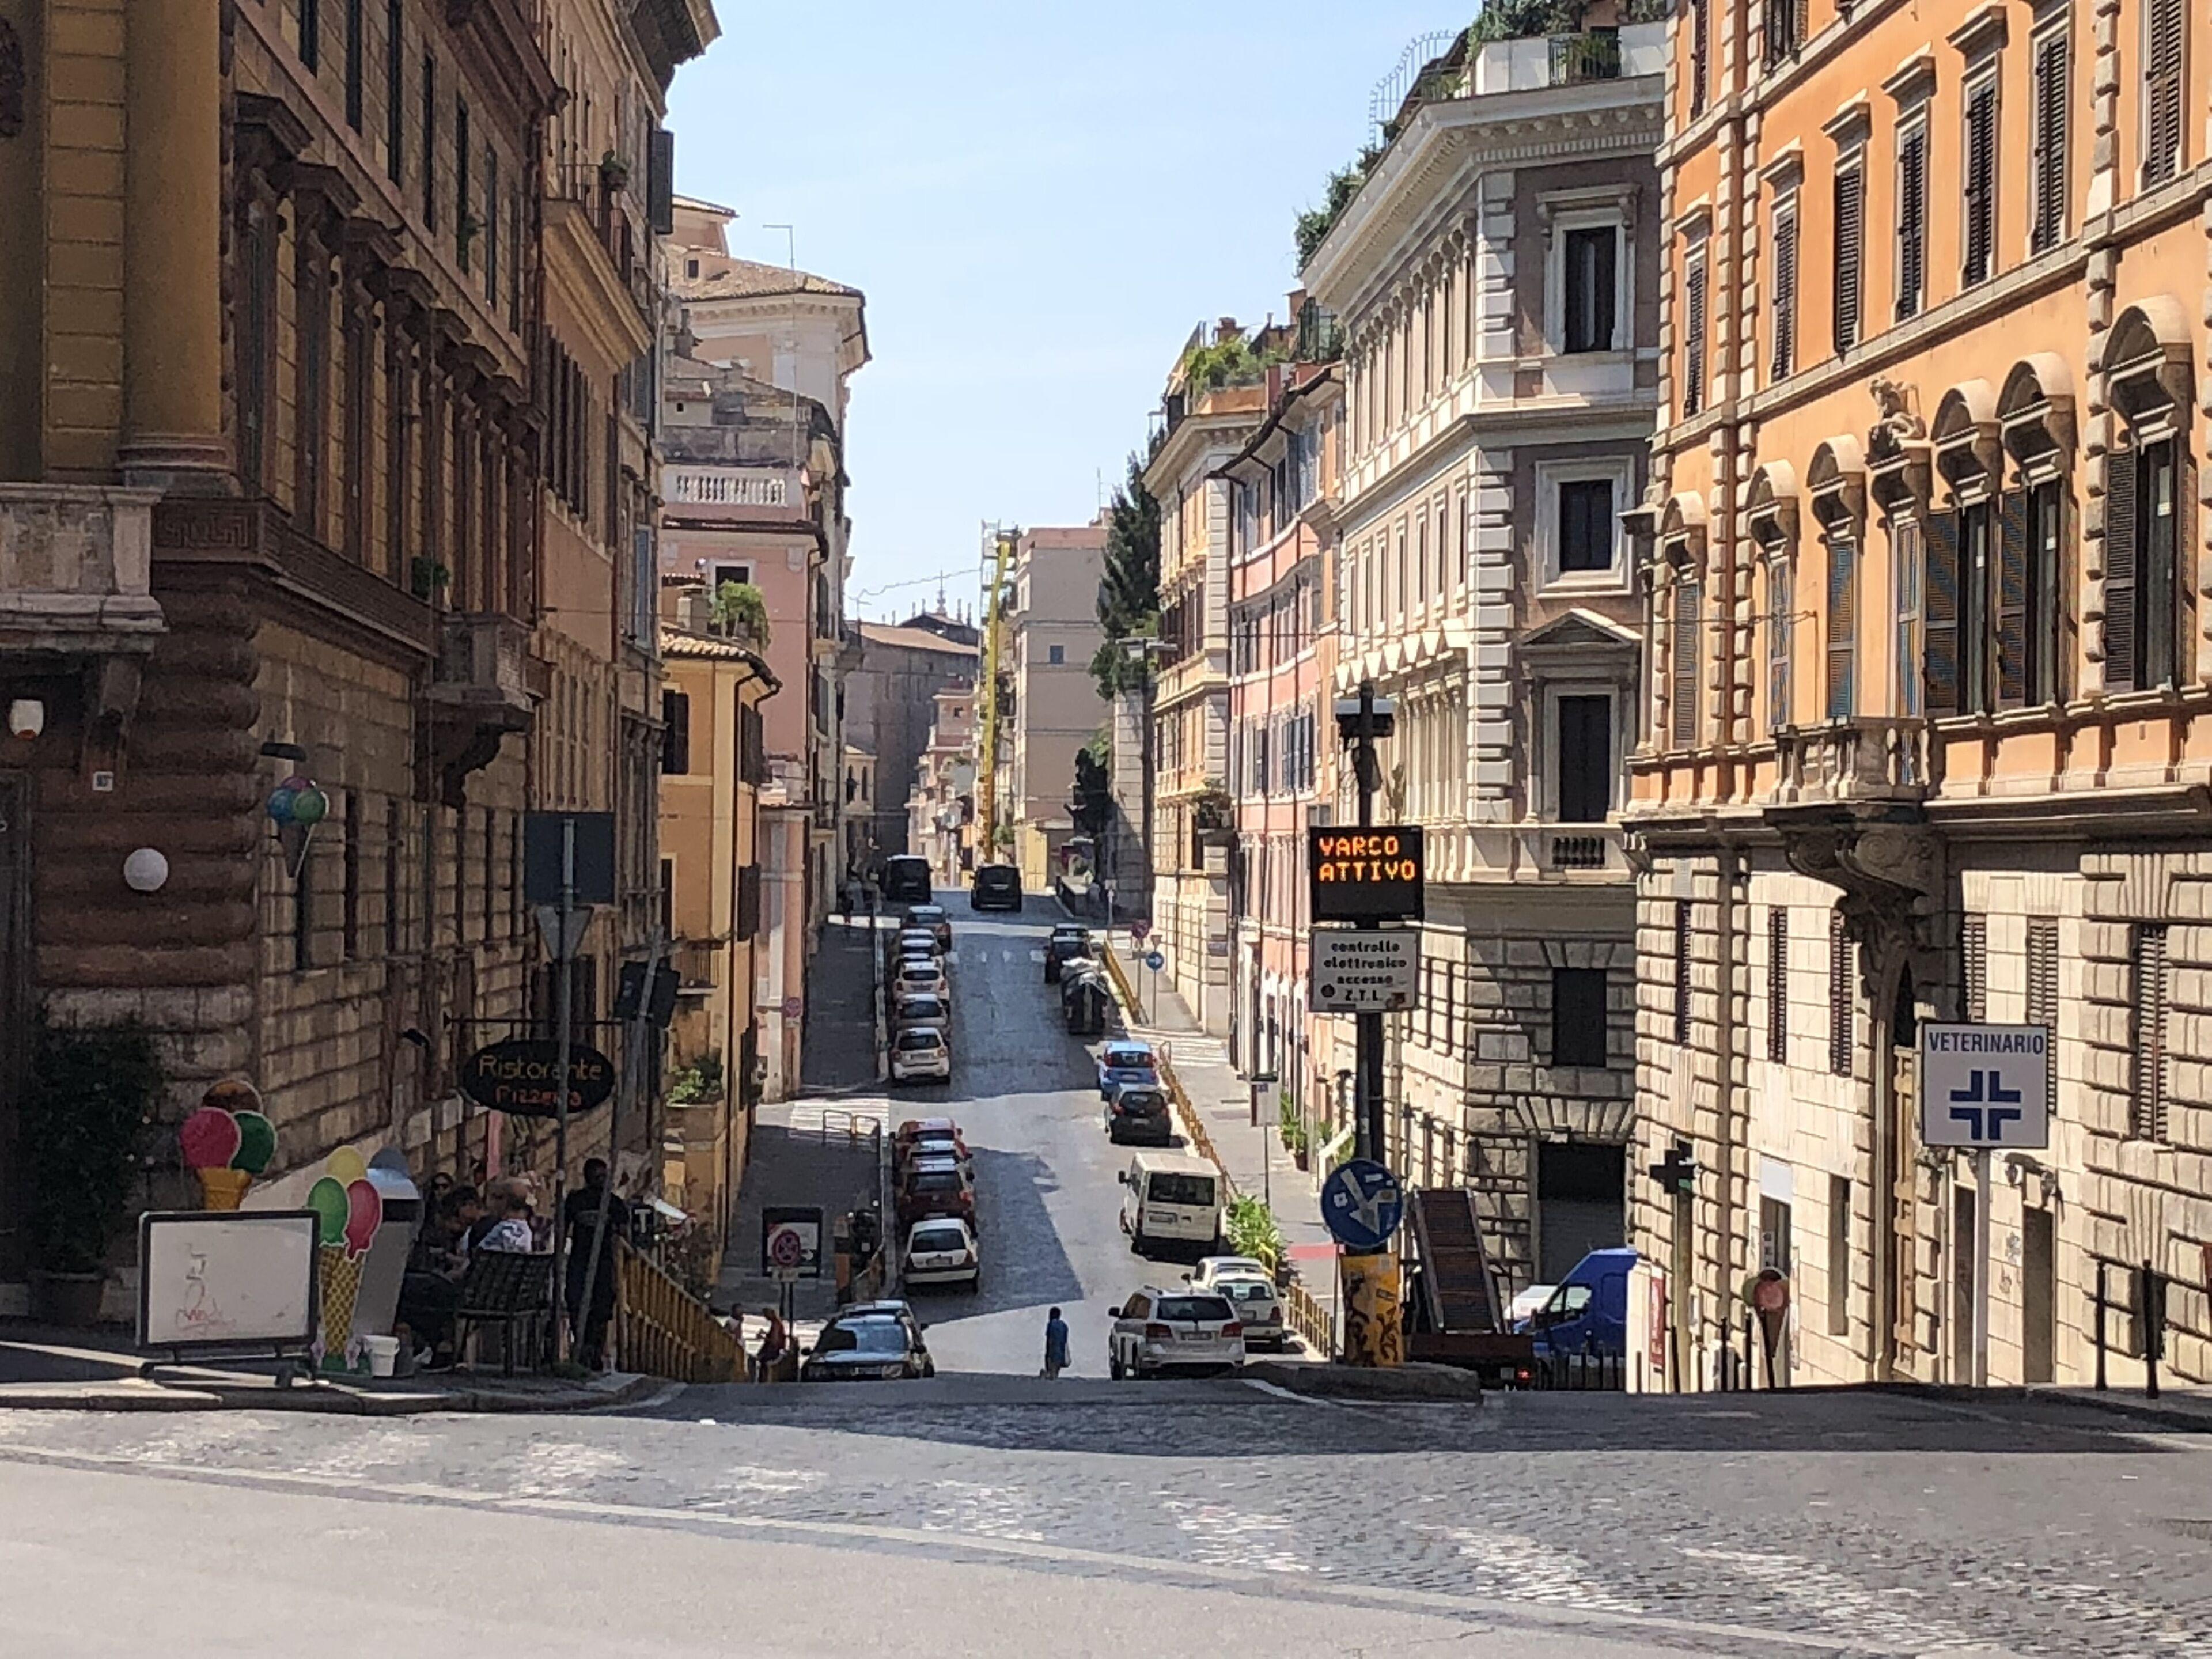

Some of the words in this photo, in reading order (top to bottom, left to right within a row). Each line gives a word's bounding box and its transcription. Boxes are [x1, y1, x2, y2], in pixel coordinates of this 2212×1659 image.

[1319, 836, 1399, 857] VARCO
[1319, 859, 1416, 882] ATTIVO
[1331, 940, 1400, 952] controllo
[1323, 956, 1407, 969] elettronico
[1929, 1032, 2044, 1055] VETERINARIO
[634, 1209, 652, 1234] T
